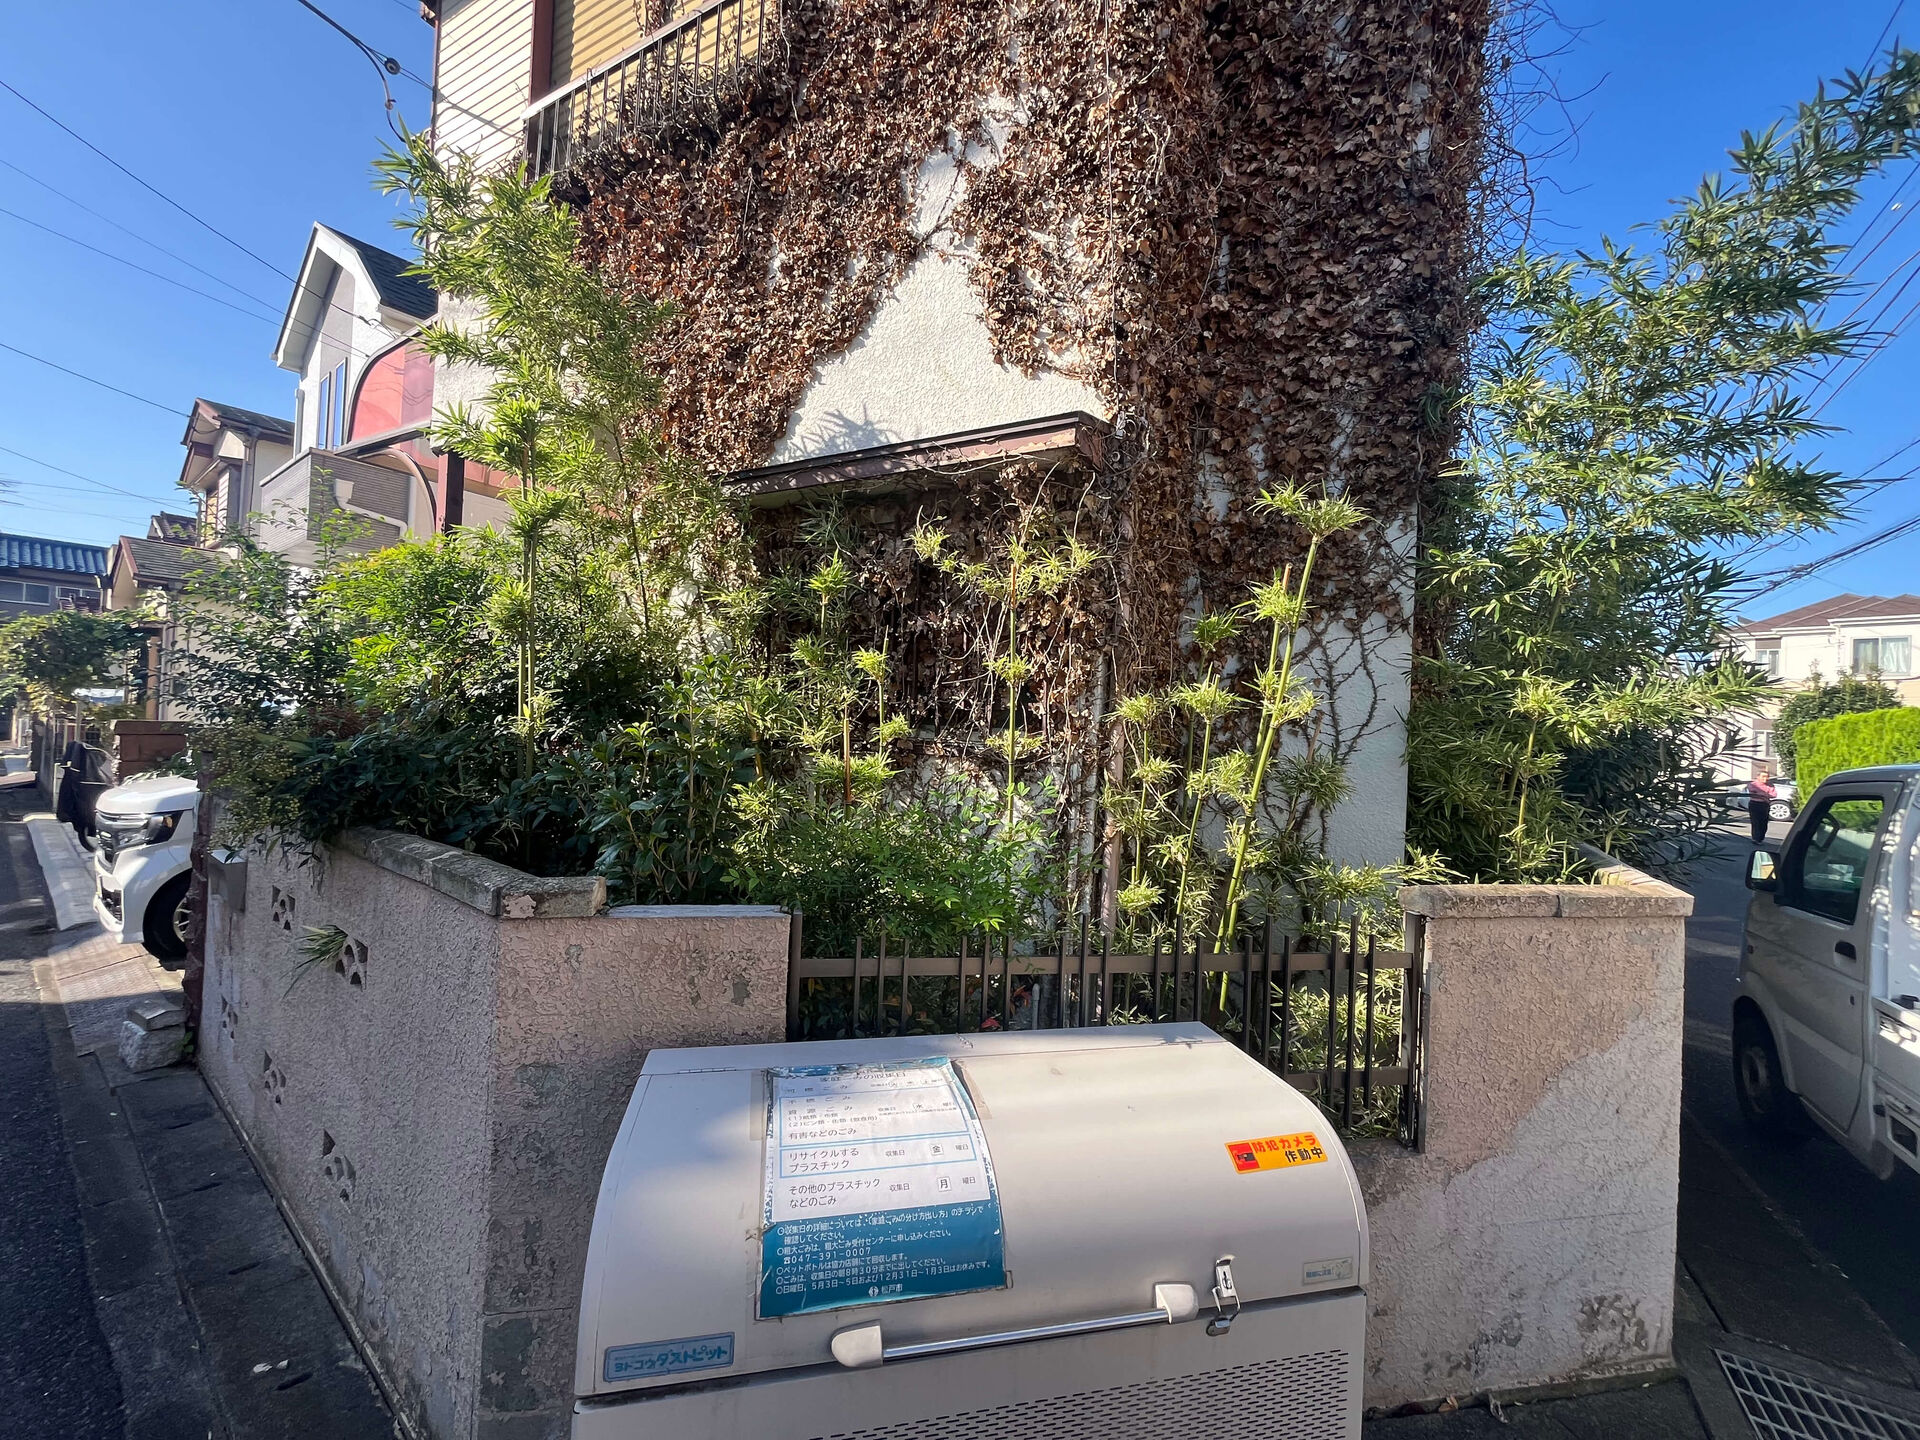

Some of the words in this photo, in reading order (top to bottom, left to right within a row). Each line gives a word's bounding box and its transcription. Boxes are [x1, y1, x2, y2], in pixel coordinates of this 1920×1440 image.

[885, 1149, 905, 1157] 収集日
[932, 1145, 942, 1154] 金
[1251, 1134, 1317, 1153] 防犯カメラ
[789, 1147, 859, 1161] リサイクルする
[1284, 1147, 1324, 1163] 作動中
[789, 1159, 850, 1174] プラスチック
[789, 1178, 881, 1195] その他のプラスチック
[889, 1183, 910, 1192] 収集日
[940, 1179, 949, 1189] 月
[962, 1176, 976, 1185] 曜日
[789, 1195, 837, 1209] などのごみ
[791, 1246, 871, 1263] 047-391-0007
